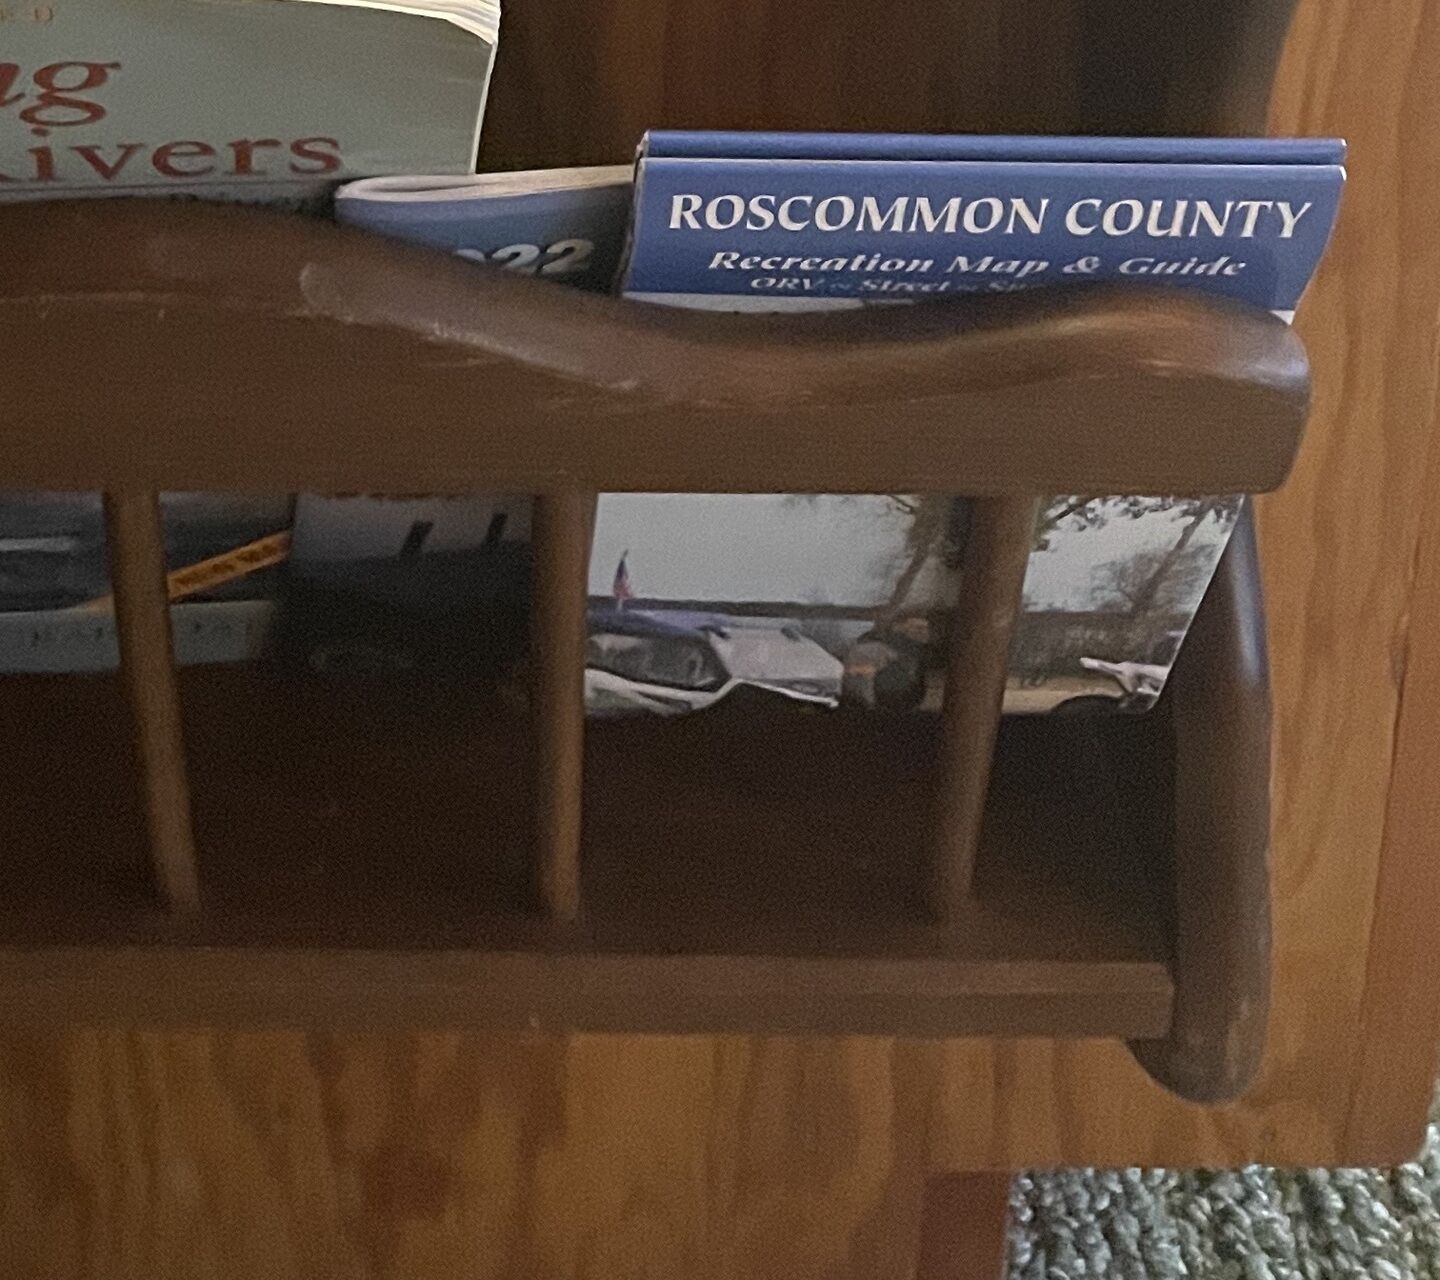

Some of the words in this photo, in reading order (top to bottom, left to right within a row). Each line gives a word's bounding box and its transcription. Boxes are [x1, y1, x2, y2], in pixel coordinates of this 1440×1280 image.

[668, 192, 1051, 235] ROSCOMMON
[1064, 197, 1314, 240] COUNTY
[708, 250, 935, 275] Recreation
[945, 254, 1050, 279] Map
[1061, 255, 1102, 275] &
[1117, 256, 1248, 277] Guide
[749, 277, 818, 291] ORV
[862, 276, 951, 292] Street
